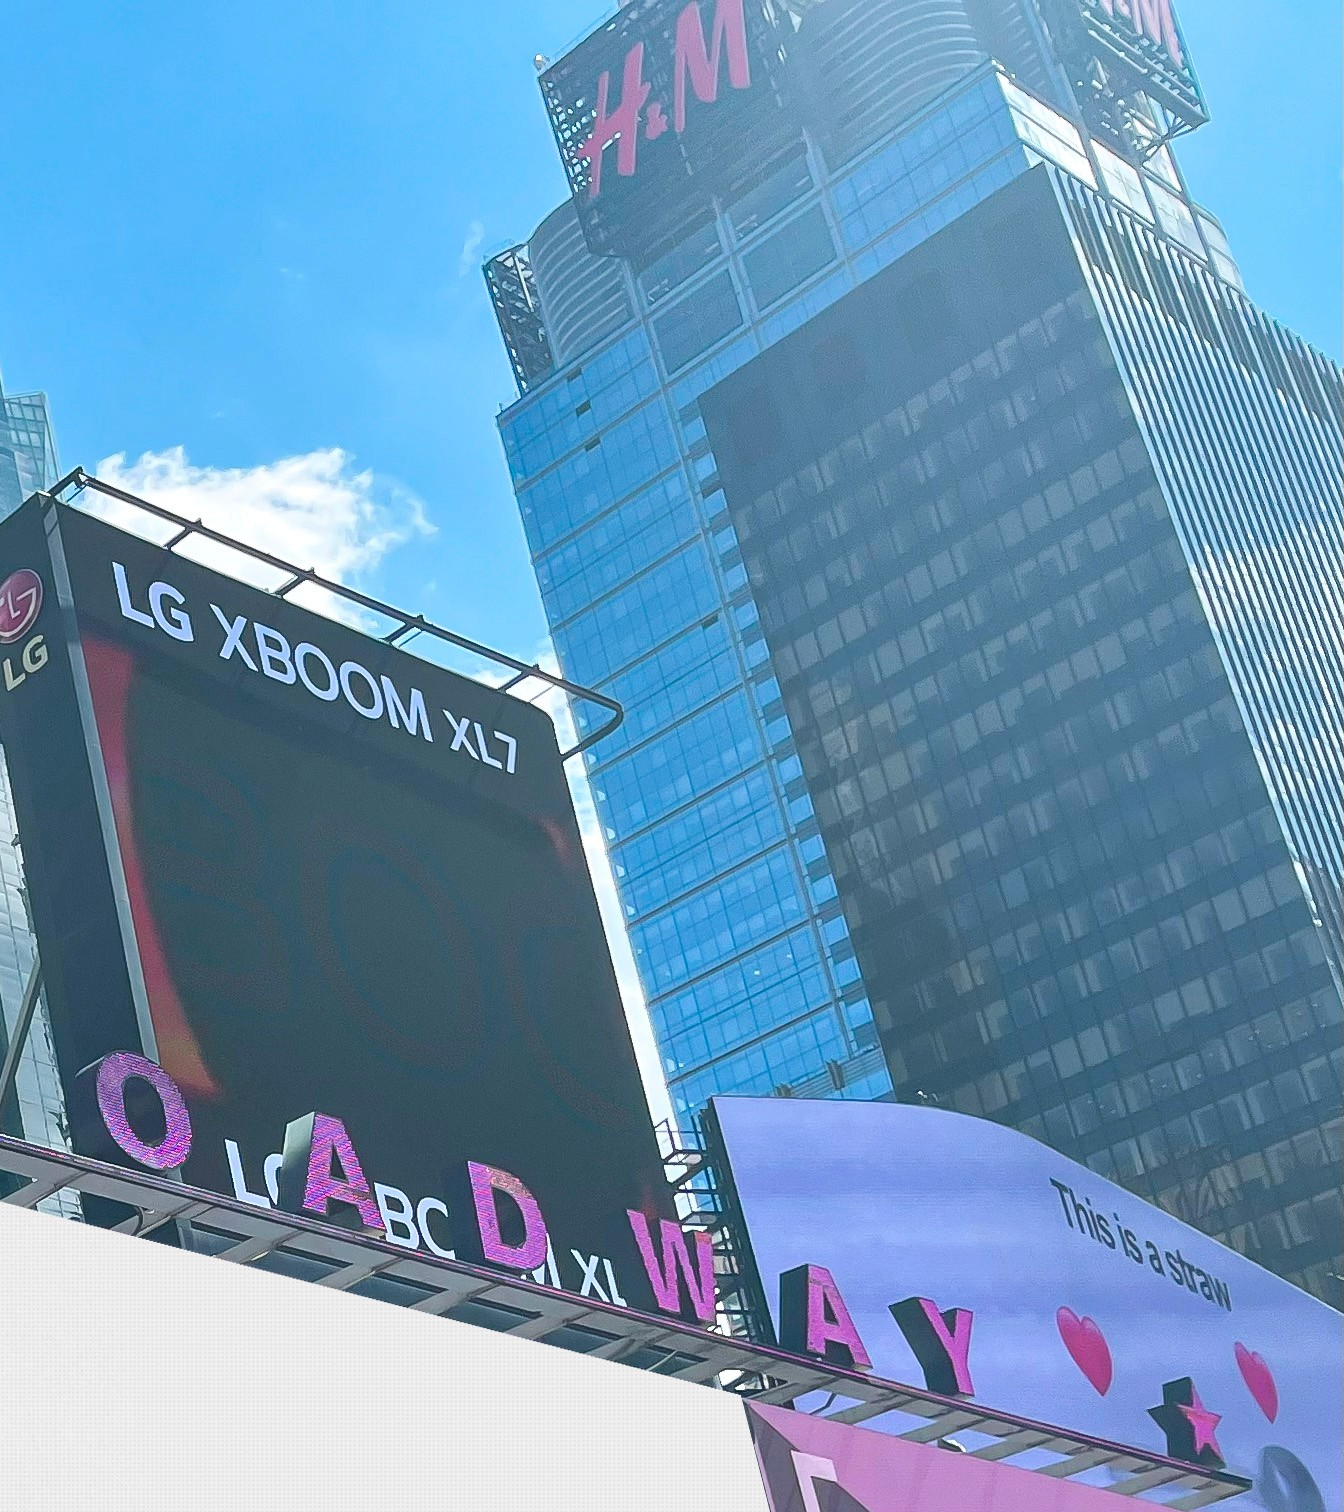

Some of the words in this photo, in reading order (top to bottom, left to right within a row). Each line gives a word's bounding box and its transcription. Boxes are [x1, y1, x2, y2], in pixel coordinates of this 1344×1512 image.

[576, 0, 752, 198] H&M
[2, 635, 49, 691] LG
[113, 562, 194, 642] LG
[210, 602, 433, 743] XBOOM
[442, 709, 517, 774] XL7
[1049, 1177, 1116, 1249] This
[1113, 1212, 1143, 1264] is
[1145, 1240, 1165, 1277] a
[1164, 1249, 1232, 1313] straw
